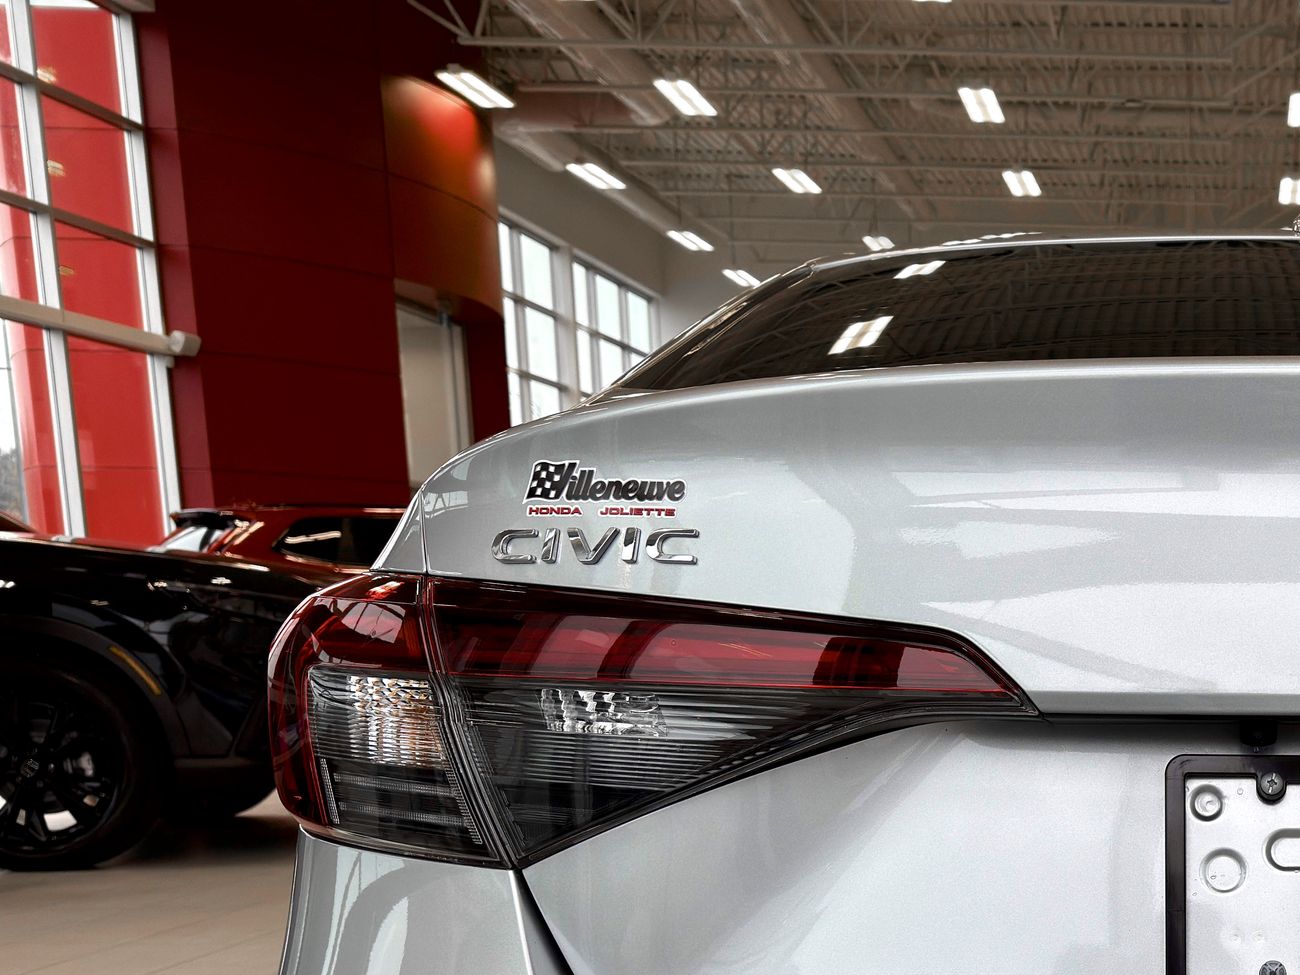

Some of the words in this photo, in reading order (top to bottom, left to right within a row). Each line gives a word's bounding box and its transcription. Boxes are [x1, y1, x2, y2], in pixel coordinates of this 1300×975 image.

[528, 507, 582, 516] HONDA
[600, 508, 676, 517] JOLIETTE
[491, 527, 700, 565] CIVIC
